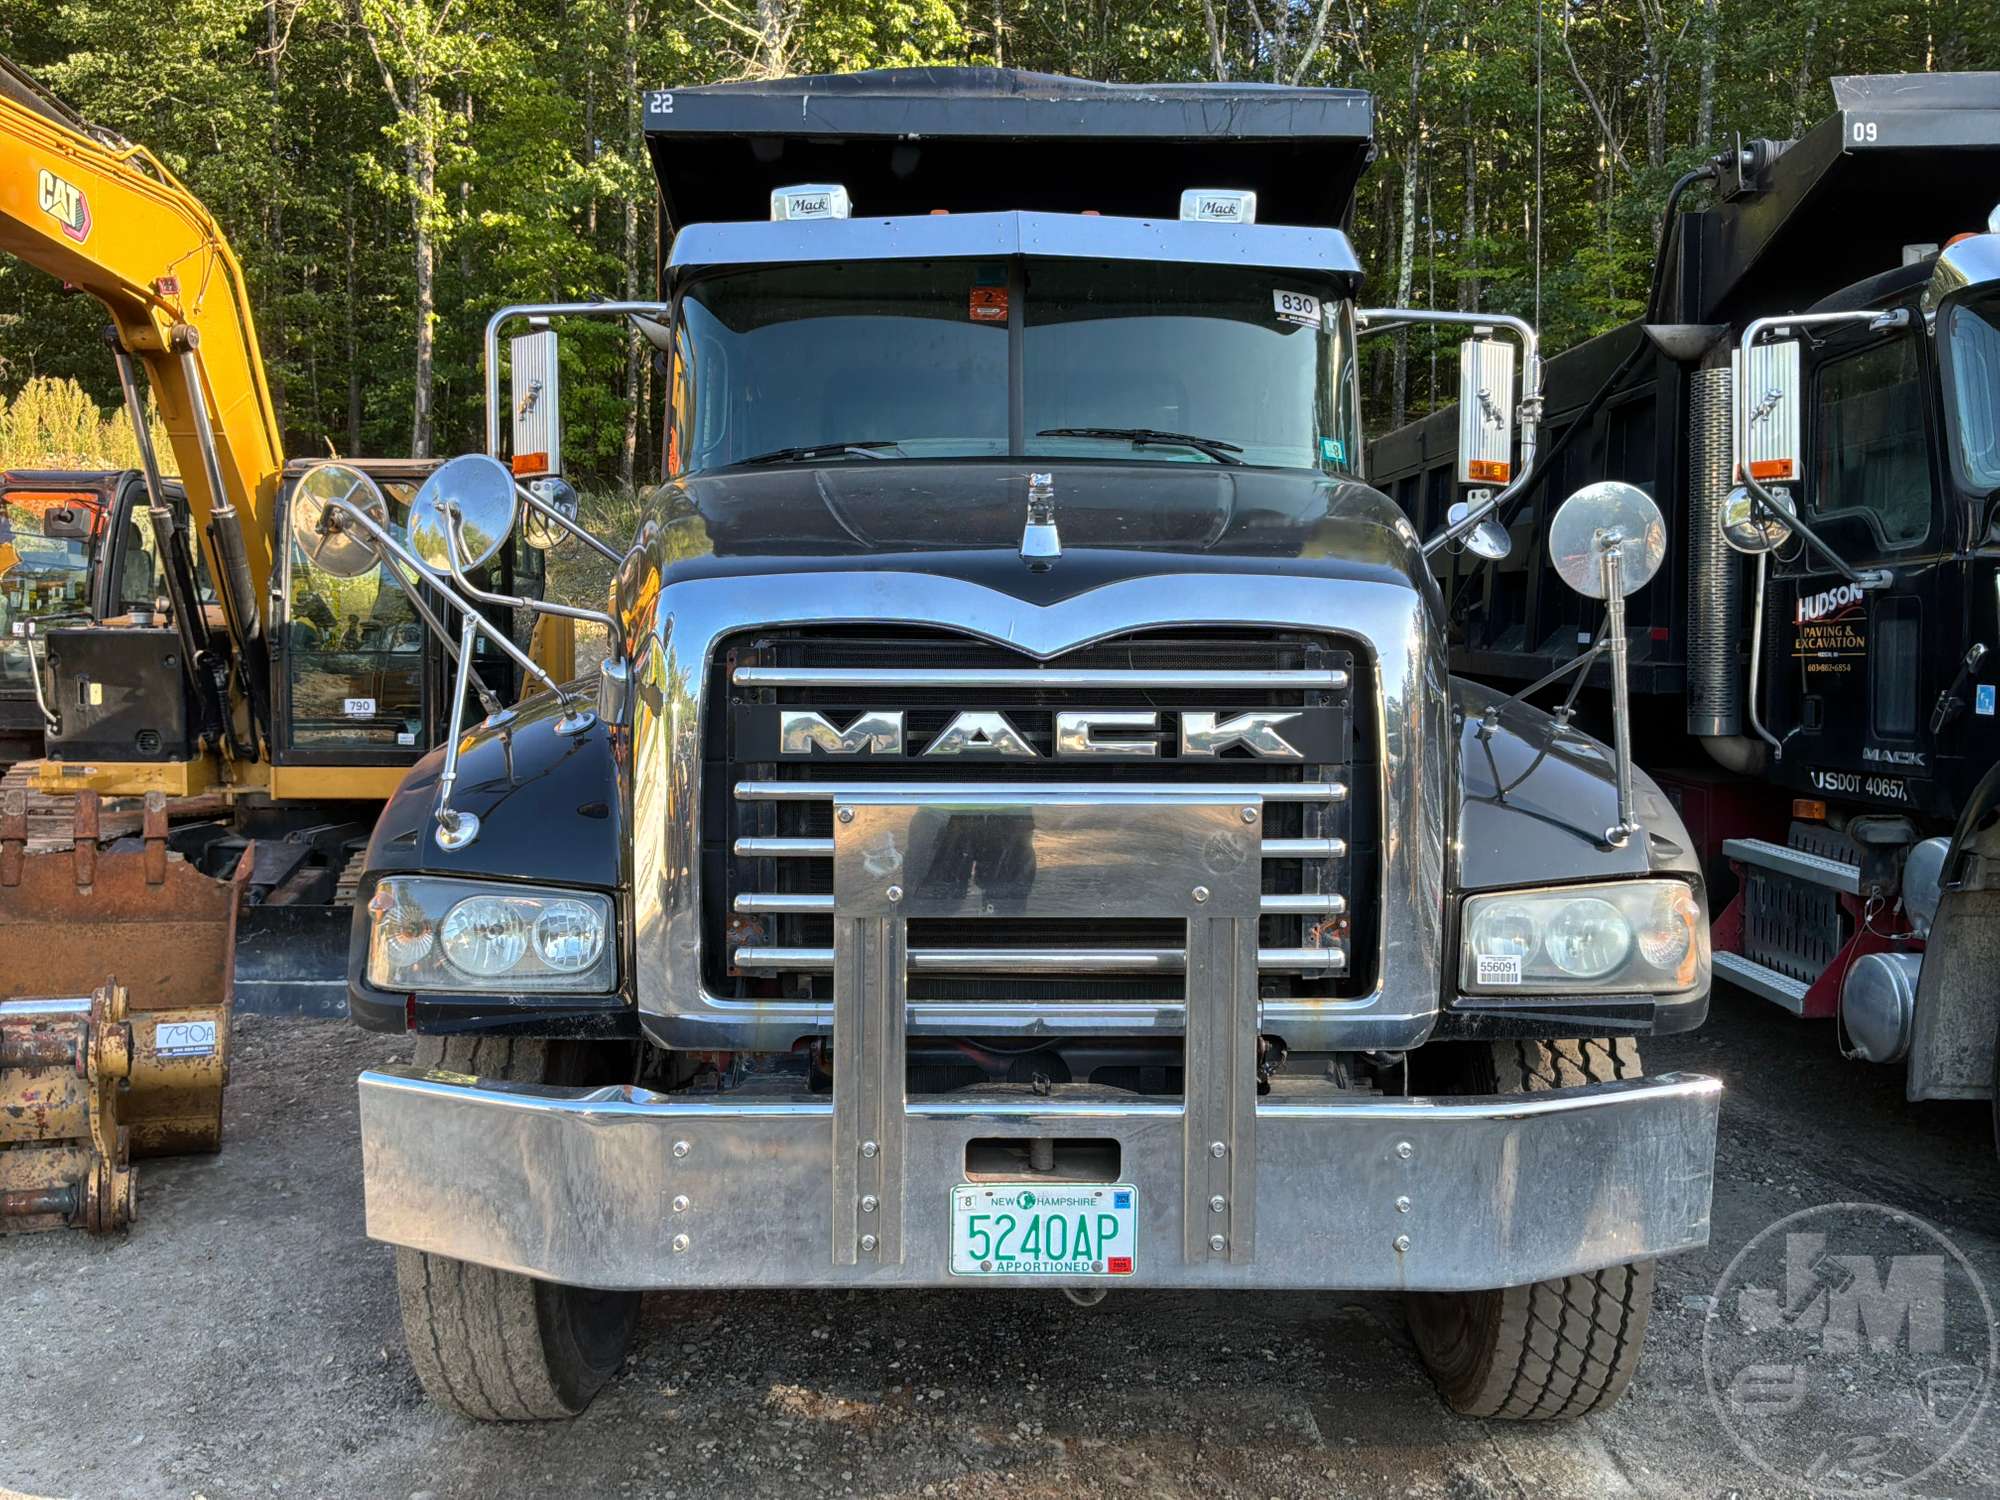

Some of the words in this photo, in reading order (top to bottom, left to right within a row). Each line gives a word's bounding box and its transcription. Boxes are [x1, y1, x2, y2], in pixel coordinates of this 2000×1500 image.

[651, 93, 673, 113] 22
[1853, 122, 1877, 142] 09
[39, 169, 81, 228] CAT
[792, 198, 828, 212] Mack
[1202, 202, 1238, 215] Mack
[1282, 294, 1313, 314] 830
[1798, 582, 1863, 622] HUDSON
[1804, 625, 1842, 637] PAVING
[1845, 625, 1855, 636] &
[1795, 636, 1865, 649] EXCAVATION
[350, 701, 370, 711] 790
[779, 710, 1304, 758] MACK
[1862, 747, 1925, 766] MACK
[1810, 771, 1861, 793] USDOT
[1480, 961, 1516, 973] 556091
[161, 1024, 214, 1045] 790A
[965, 1197, 972, 1207] 8
[991, 1197, 1016, 1207] NEW
[1037, 1197, 1097, 1207] HAMPSHIRE
[969, 1214, 1119, 1261] 5240AP
[997, 1262, 1090, 1272] APPORTIONED
